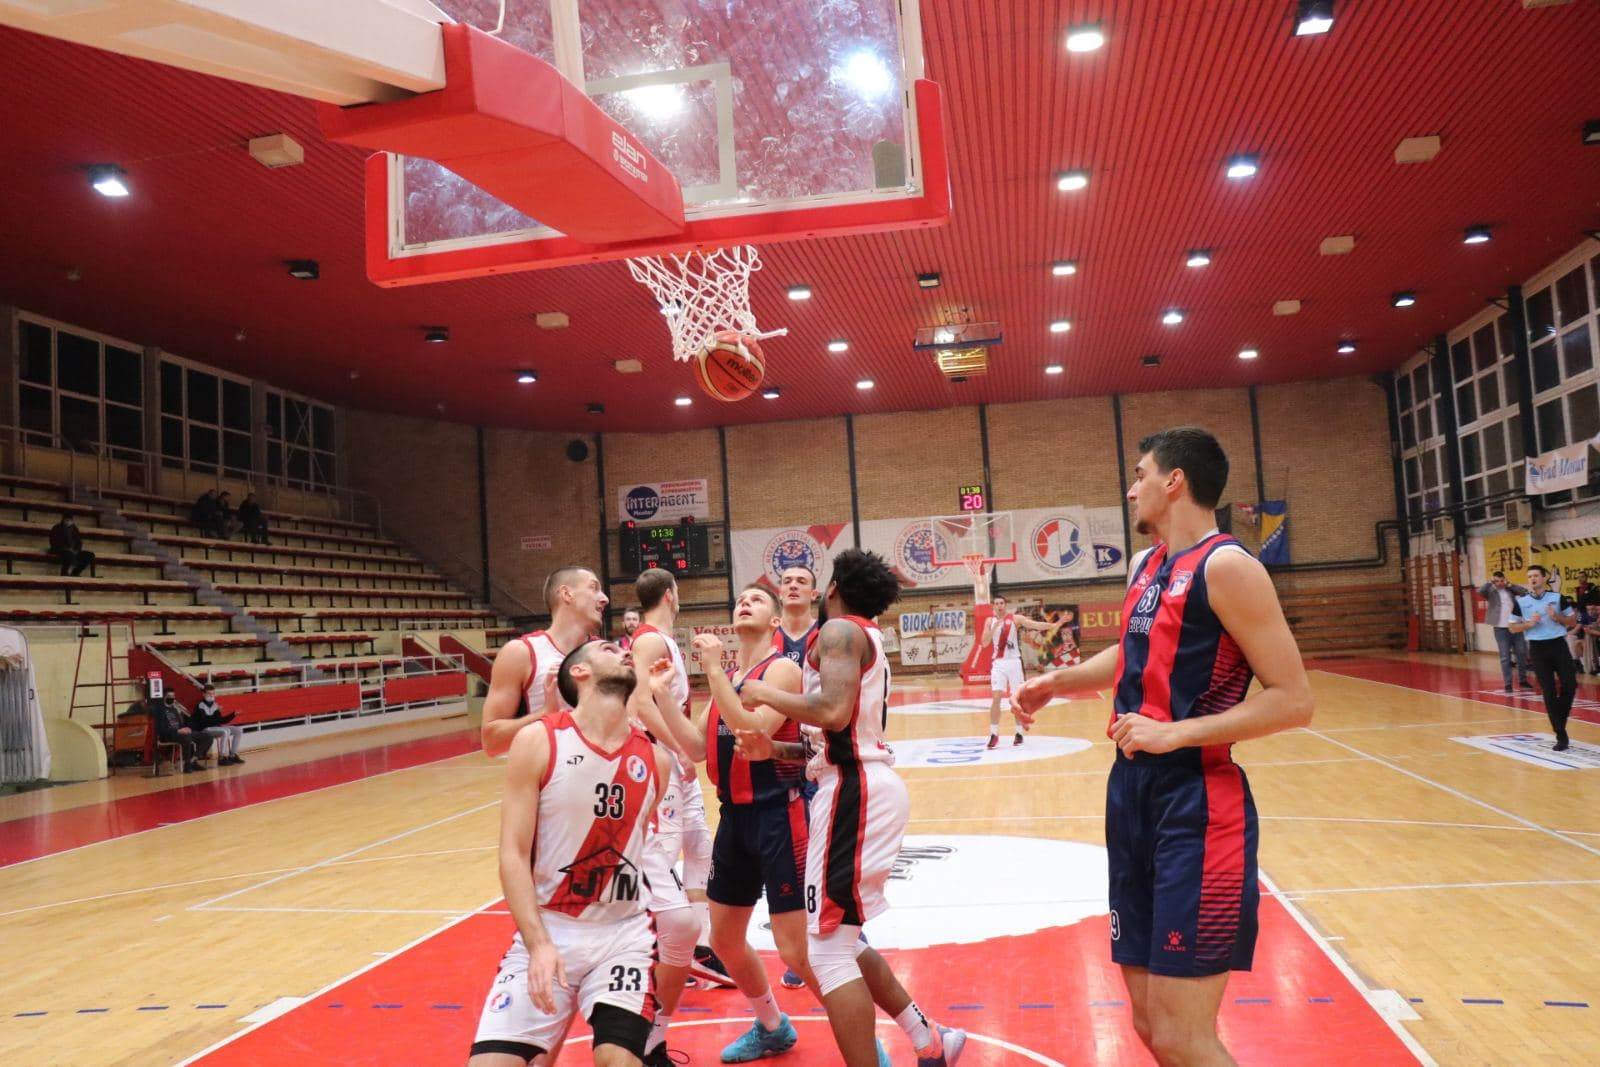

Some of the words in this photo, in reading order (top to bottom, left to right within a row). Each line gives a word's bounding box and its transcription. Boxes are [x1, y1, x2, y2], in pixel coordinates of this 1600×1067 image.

[963, 494, 982, 509] 20
[1499, 546, 1524, 571] FIS
[594, 782, 624, 820] 33
[807, 884, 816, 914] 8
[608, 965, 642, 992] 33
